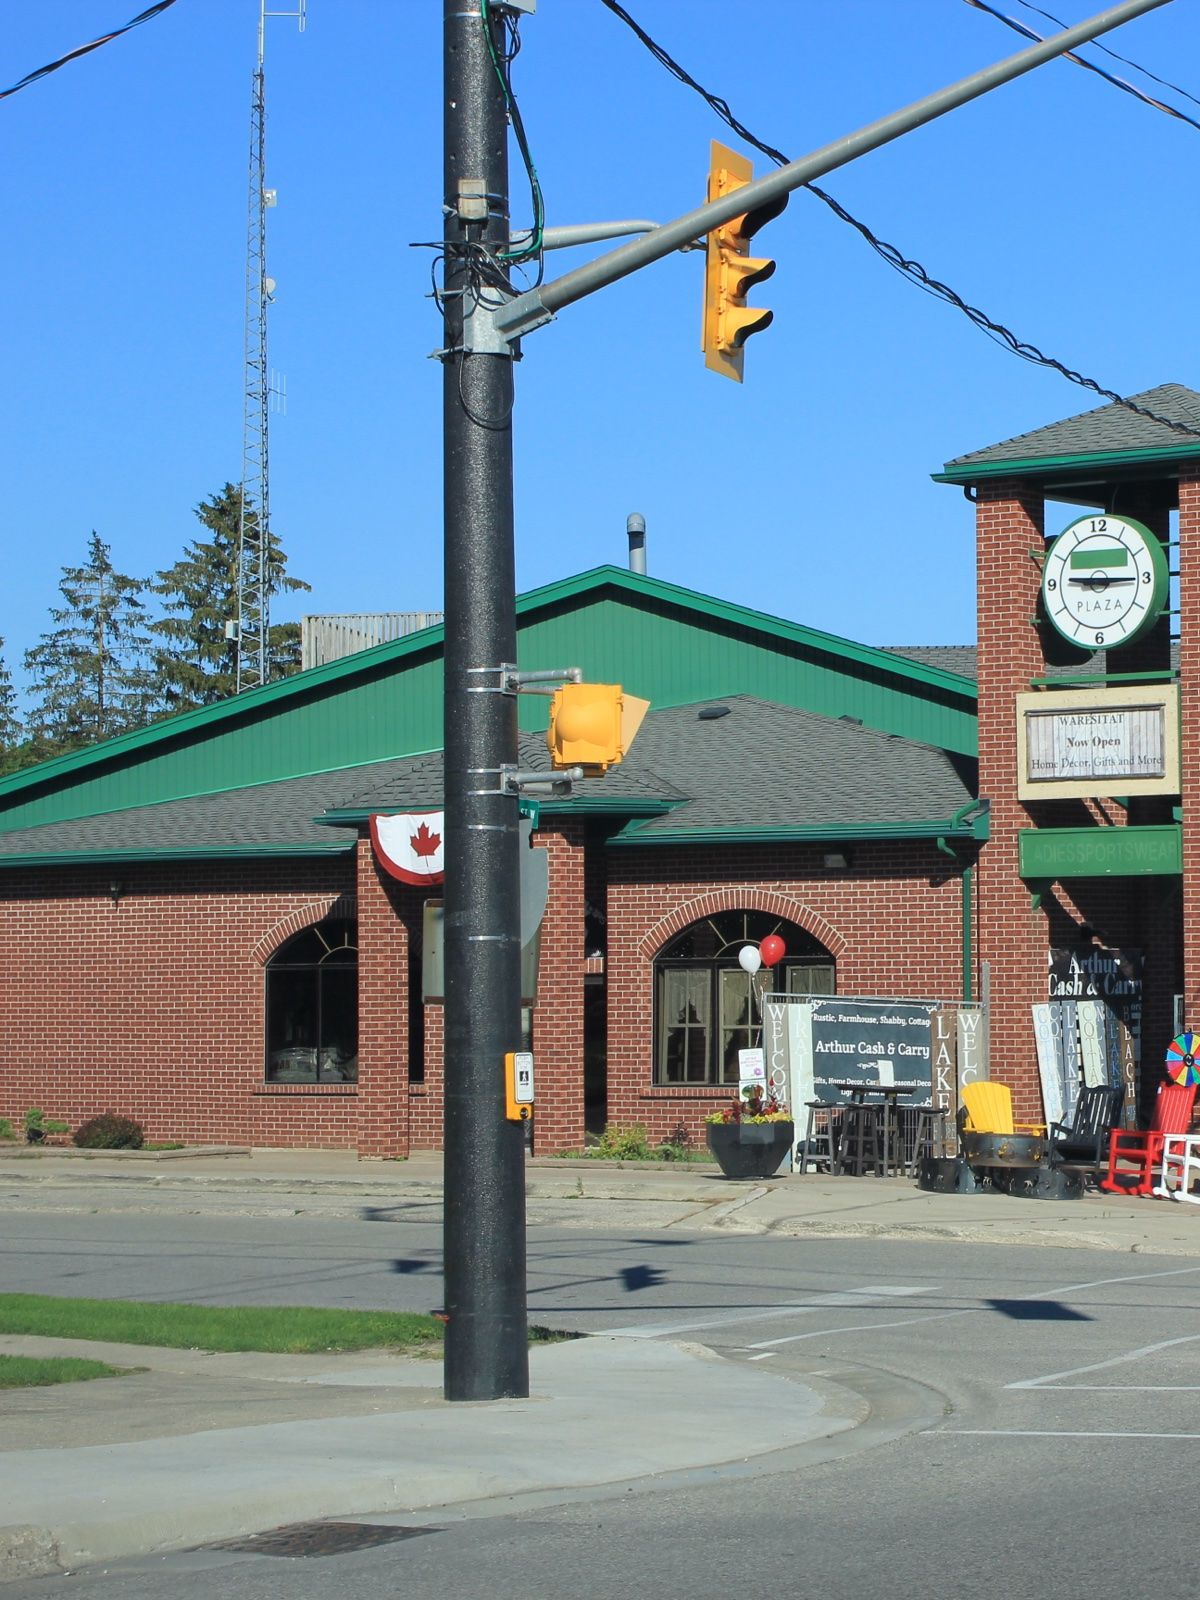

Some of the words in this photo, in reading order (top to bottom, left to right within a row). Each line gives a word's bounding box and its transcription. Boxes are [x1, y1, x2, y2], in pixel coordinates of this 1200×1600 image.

[1090, 519, 1107, 532] 12
[1047, 578, 1057, 591] 9
[1142, 571, 1151, 584] 3
[1077, 599, 1123, 612] PLAZA
[1094, 632, 1104, 644] 6
[1059, 713, 1125, 726] WARESITAT
[1066, 736, 1089, 748] Now
[1091, 735, 1121, 749] Open
[1031, 759, 1058, 770] Home
[1093, 756, 1116, 768] Gifts
[1118, 755, 1135, 766] and
[1137, 755, 1162, 765] More
[1069, 952, 1121, 974] Arthur
[1049, 973, 1083, 996] Cash
[813, 1013, 837, 1023] Rustic,
[838, 1014, 879, 1025] Farmhouse,
[880, 1015, 908, 1027] Shabby,
[815, 1040, 856, 1053] Arthur
[857, 1041, 886, 1055] Cash
[887, 1043, 896, 1055] &
[898, 1043, 930, 1059] Carry
[1066, 1005, 1078, 1103] LAKE
